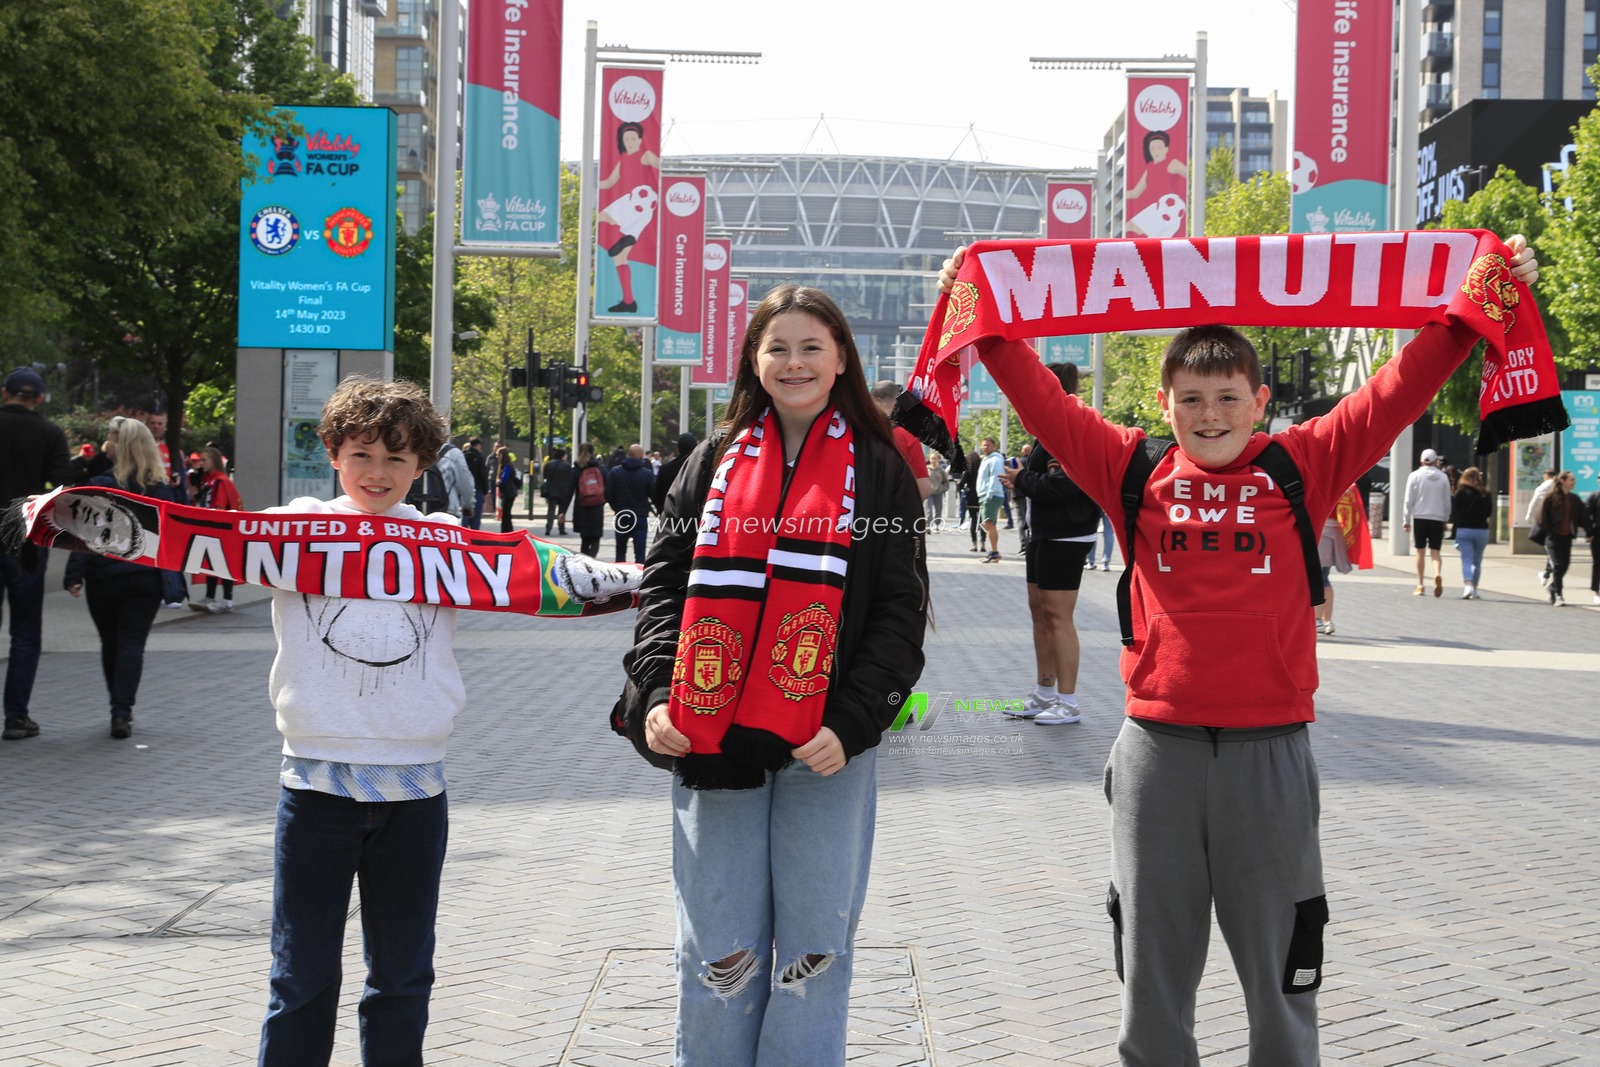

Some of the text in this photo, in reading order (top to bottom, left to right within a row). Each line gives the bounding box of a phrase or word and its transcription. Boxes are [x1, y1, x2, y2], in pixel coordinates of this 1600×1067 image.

[502, 0, 528, 150] fe insurance
[1331, 0, 1358, 163] ife insurance
[614, 88, 650, 109] Vitality
[1139, 98, 1177, 118] Vitality
[306, 129, 360, 158] Vitality
[306, 163, 359, 176] FA CUP
[505, 195, 547, 218] Vitality
[669, 192, 697, 207] Vitality
[1056, 198, 1083, 213] Vitality
[257, 206, 292, 219] CHELSEA
[1334, 208, 1376, 231] Vitality
[504, 221, 546, 231] FA CUP
[674, 233, 688, 317] Car insurance
[978, 231, 1479, 324] MAN UTD
[250, 281, 371, 293] Vitality Women's FA Cup
[298, 296, 322, 305] Final
[275, 309, 346, 321] 14th May 2023
[289, 325, 331, 334] 1430 KO
[705, 279, 717, 374] Find what moves you
[1499, 368, 1539, 399] UTD
[238, 520, 468, 546] UNITED & BRASIL
[183, 534, 512, 607] ANTONY
[780, 675, 815, 692] UNITED
[685, 692, 725, 705] UNITED
